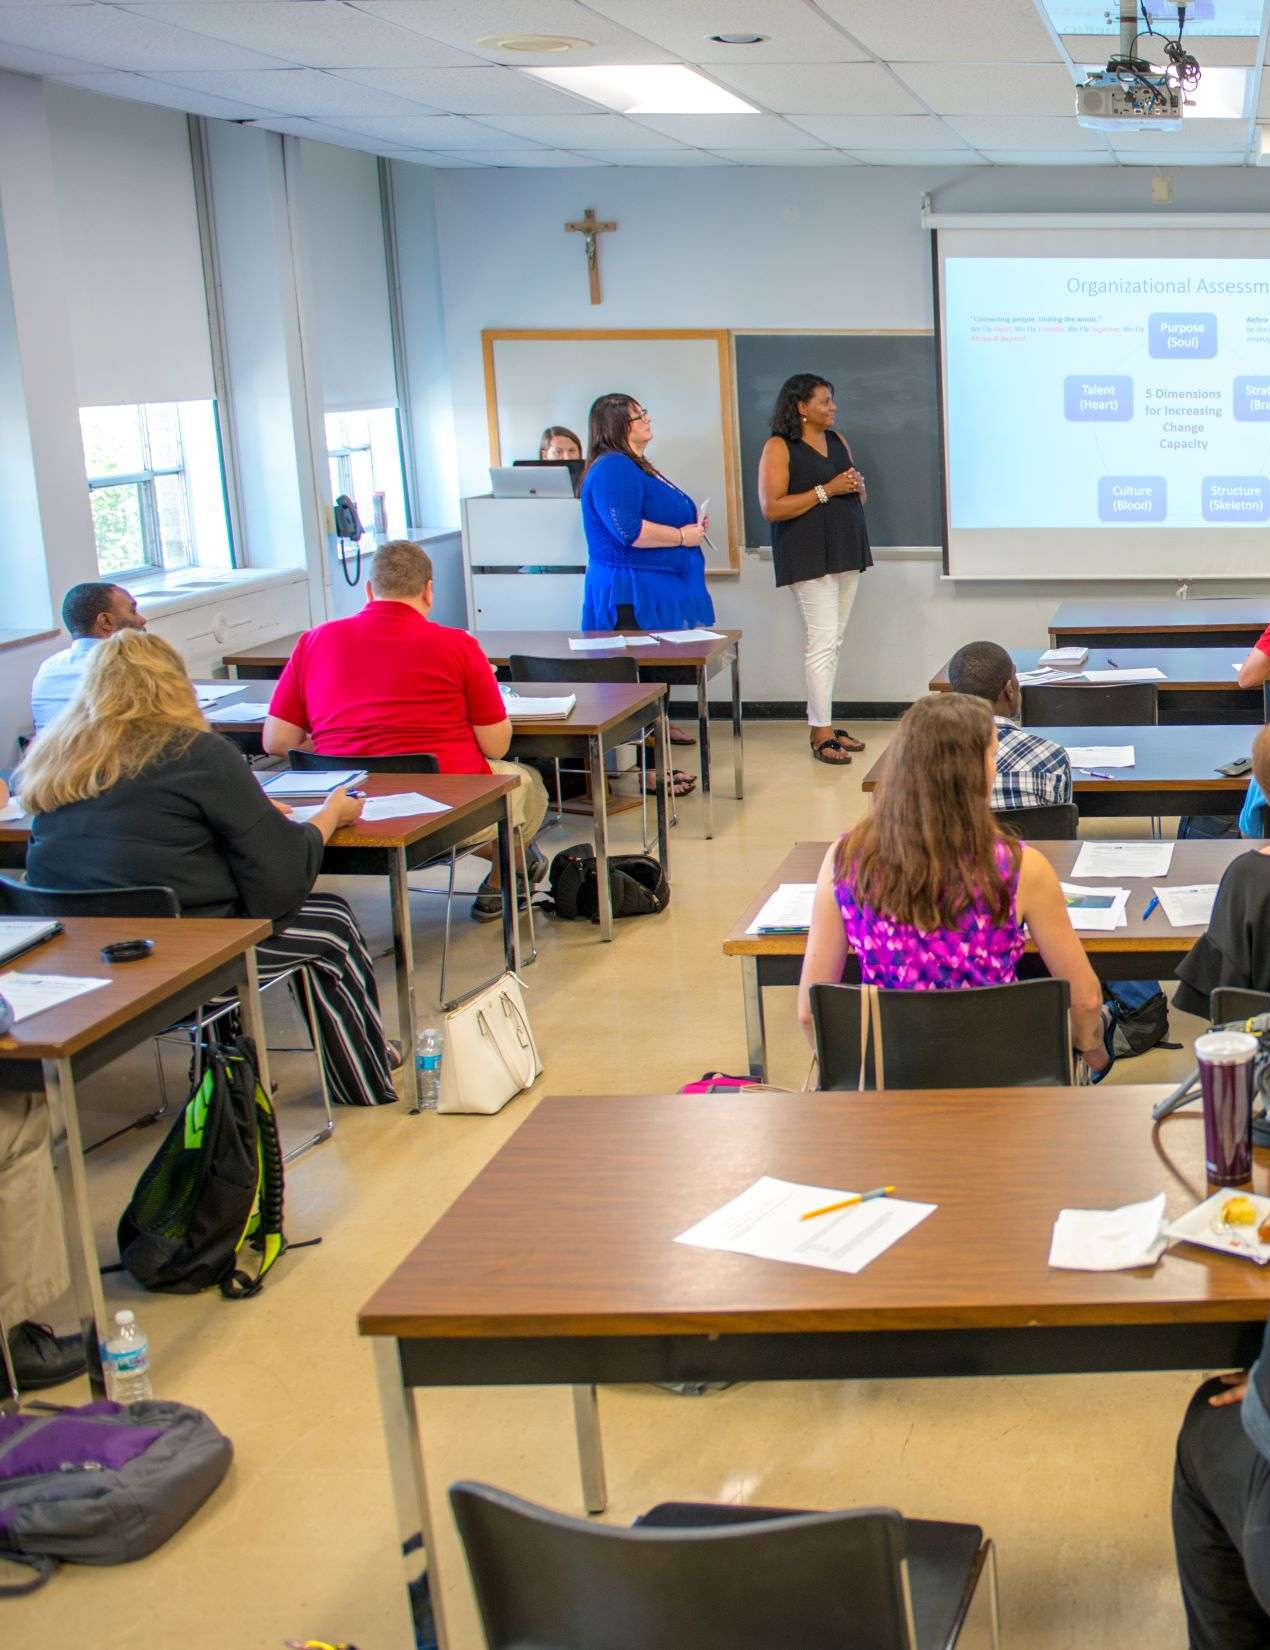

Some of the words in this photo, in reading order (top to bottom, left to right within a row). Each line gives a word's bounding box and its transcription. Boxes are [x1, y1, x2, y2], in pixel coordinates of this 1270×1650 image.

[1066, 278, 1191, 296] Organizational
[1160, 322, 1206, 335] Purpose
[1167, 337, 1199, 350] (Soul)
[1081, 384, 1116, 396] Talent
[1145, 388, 1152, 399] 5
[1156, 388, 1222, 399] Dimensions
[1079, 399, 1119, 412] (Heart)
[1145, 405, 1161, 416] for
[1164, 405, 1223, 418] Increasing
[1162, 422, 1205, 435] Change
[1159, 438, 1209, 450] Capacity
[1112, 485, 1153, 497] Culture
[1210, 485, 1263, 497] Structure
[1112, 500, 1152, 513] (Blood)
[1208, 500, 1264, 513] (Skeleton)
